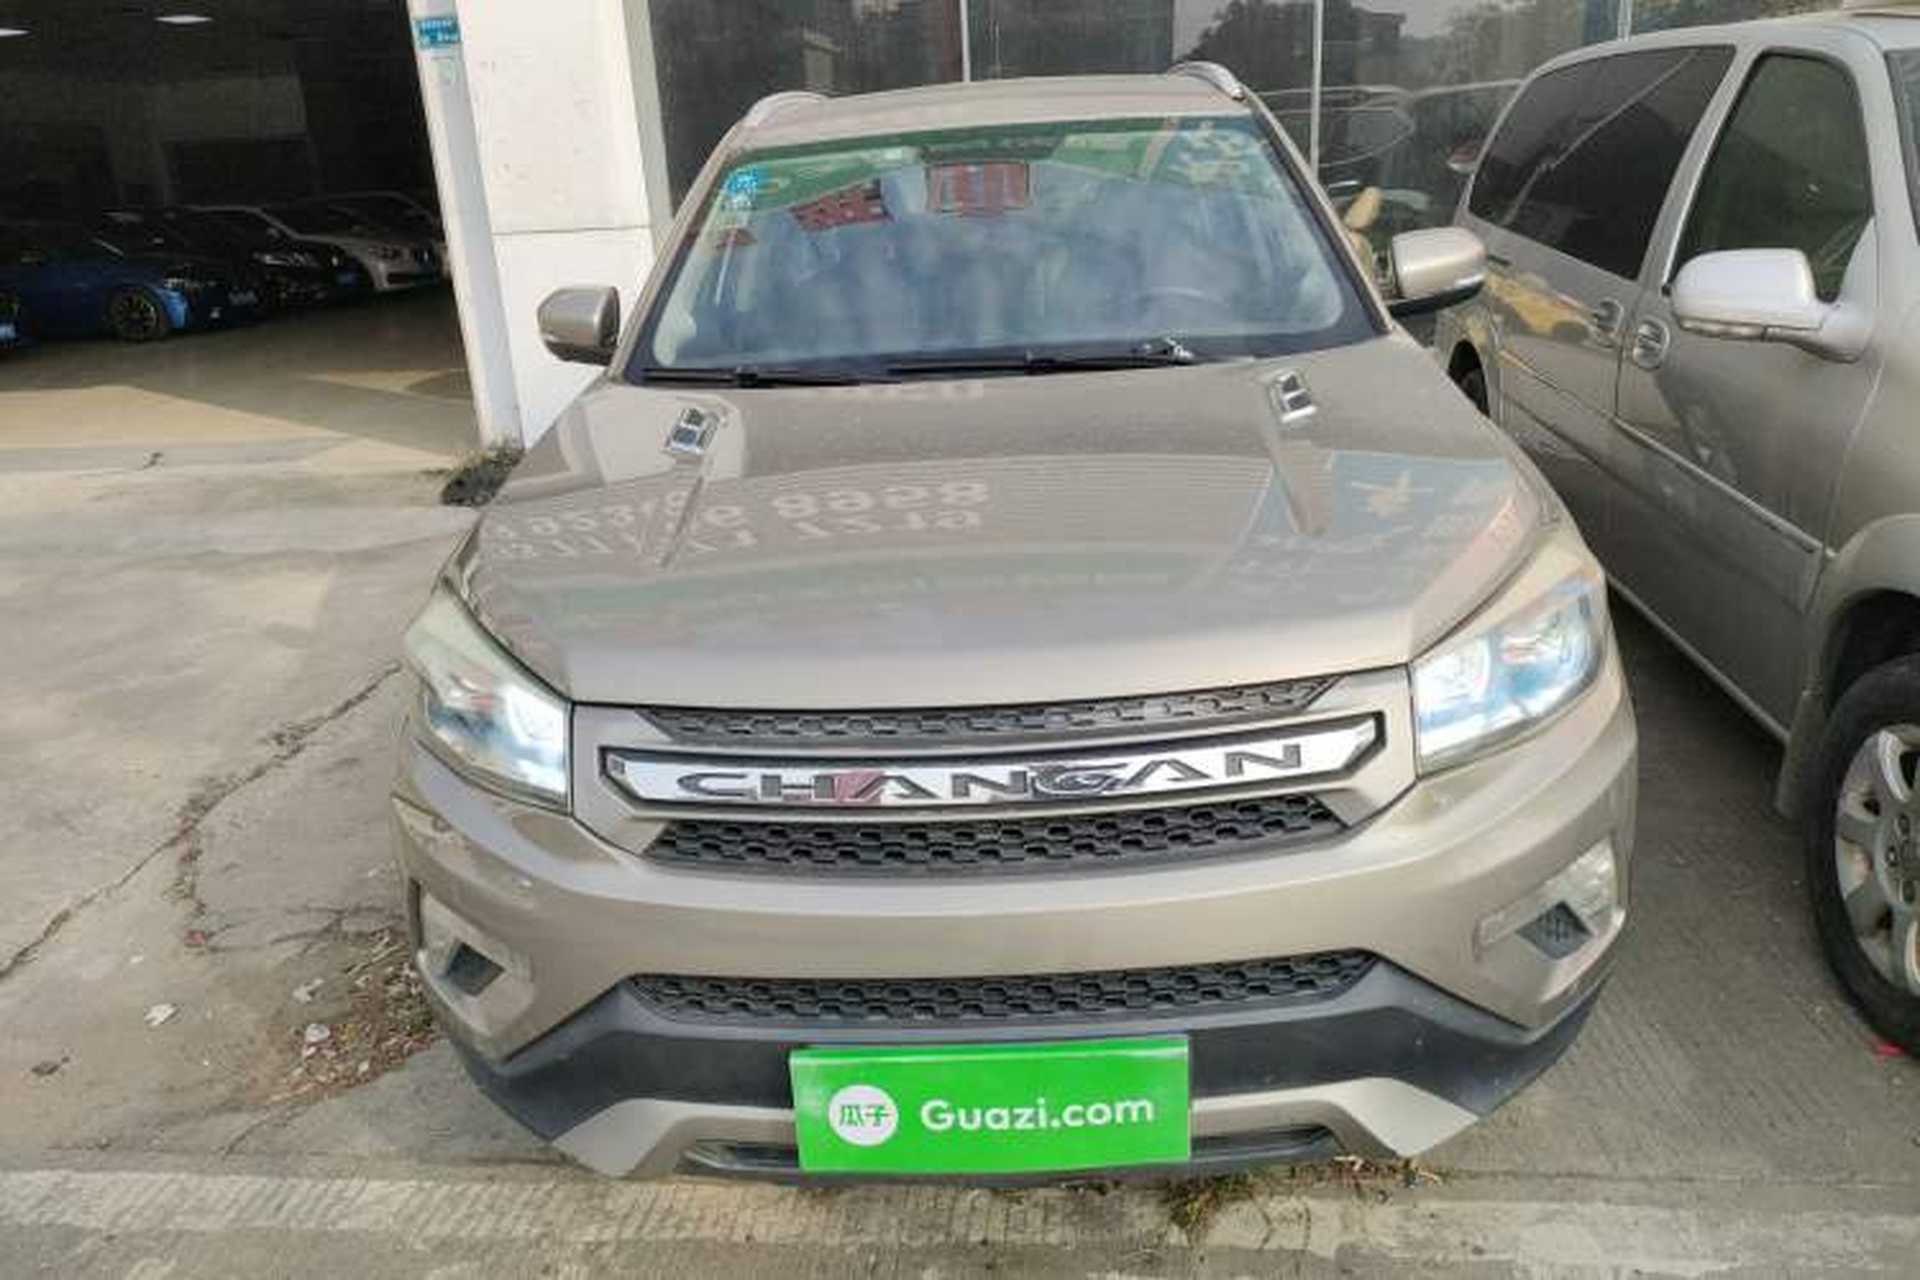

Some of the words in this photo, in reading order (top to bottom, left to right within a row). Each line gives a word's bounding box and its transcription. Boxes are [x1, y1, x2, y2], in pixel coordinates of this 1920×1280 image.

[676, 744, 1302, 801] CHANGAN
[838, 1102, 890, 1128] 瓜子
[919, 1096, 1156, 1132] Guazi.com
